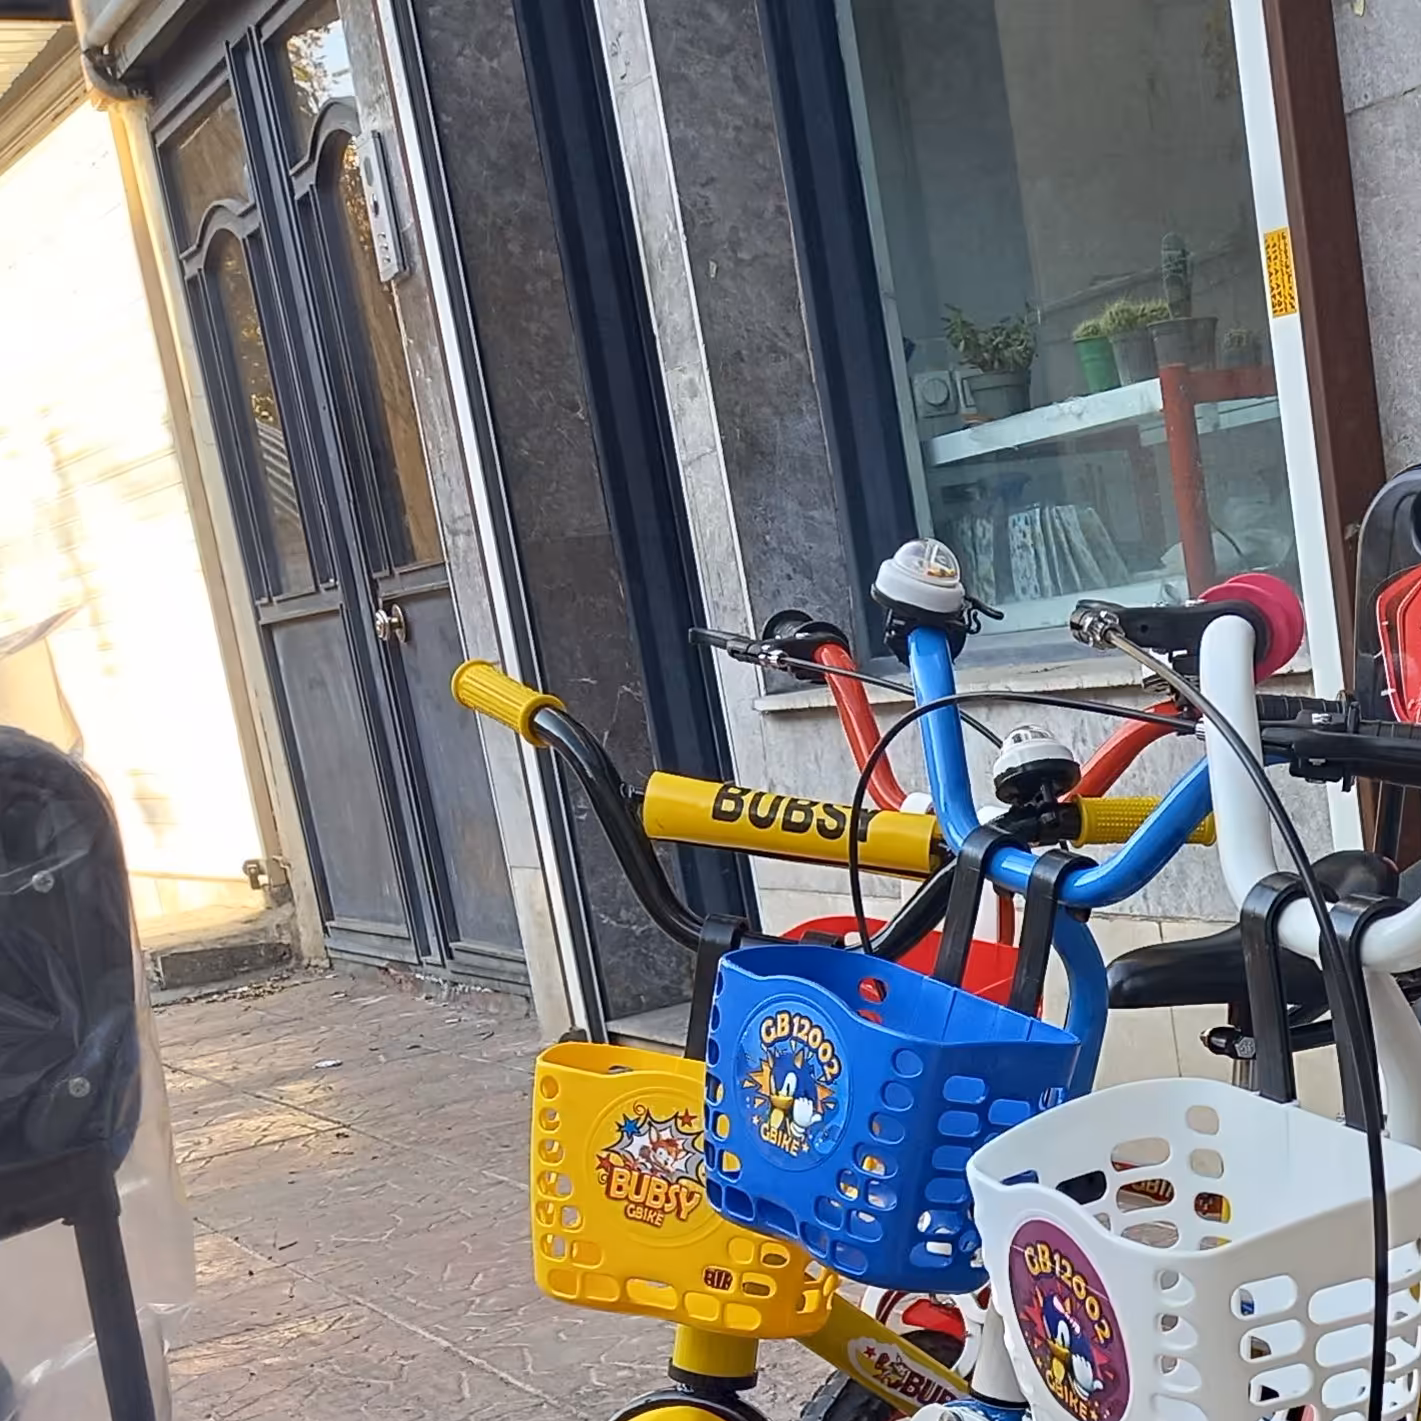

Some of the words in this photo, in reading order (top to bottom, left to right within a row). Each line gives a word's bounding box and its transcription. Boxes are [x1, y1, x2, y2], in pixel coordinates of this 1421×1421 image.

[712, 783, 880, 842] BUBSY
[760, 1123, 800, 1158] GBIKE
[605, 1166, 702, 1222] BUBSY
[625, 1203, 665, 1228] GBIKE
